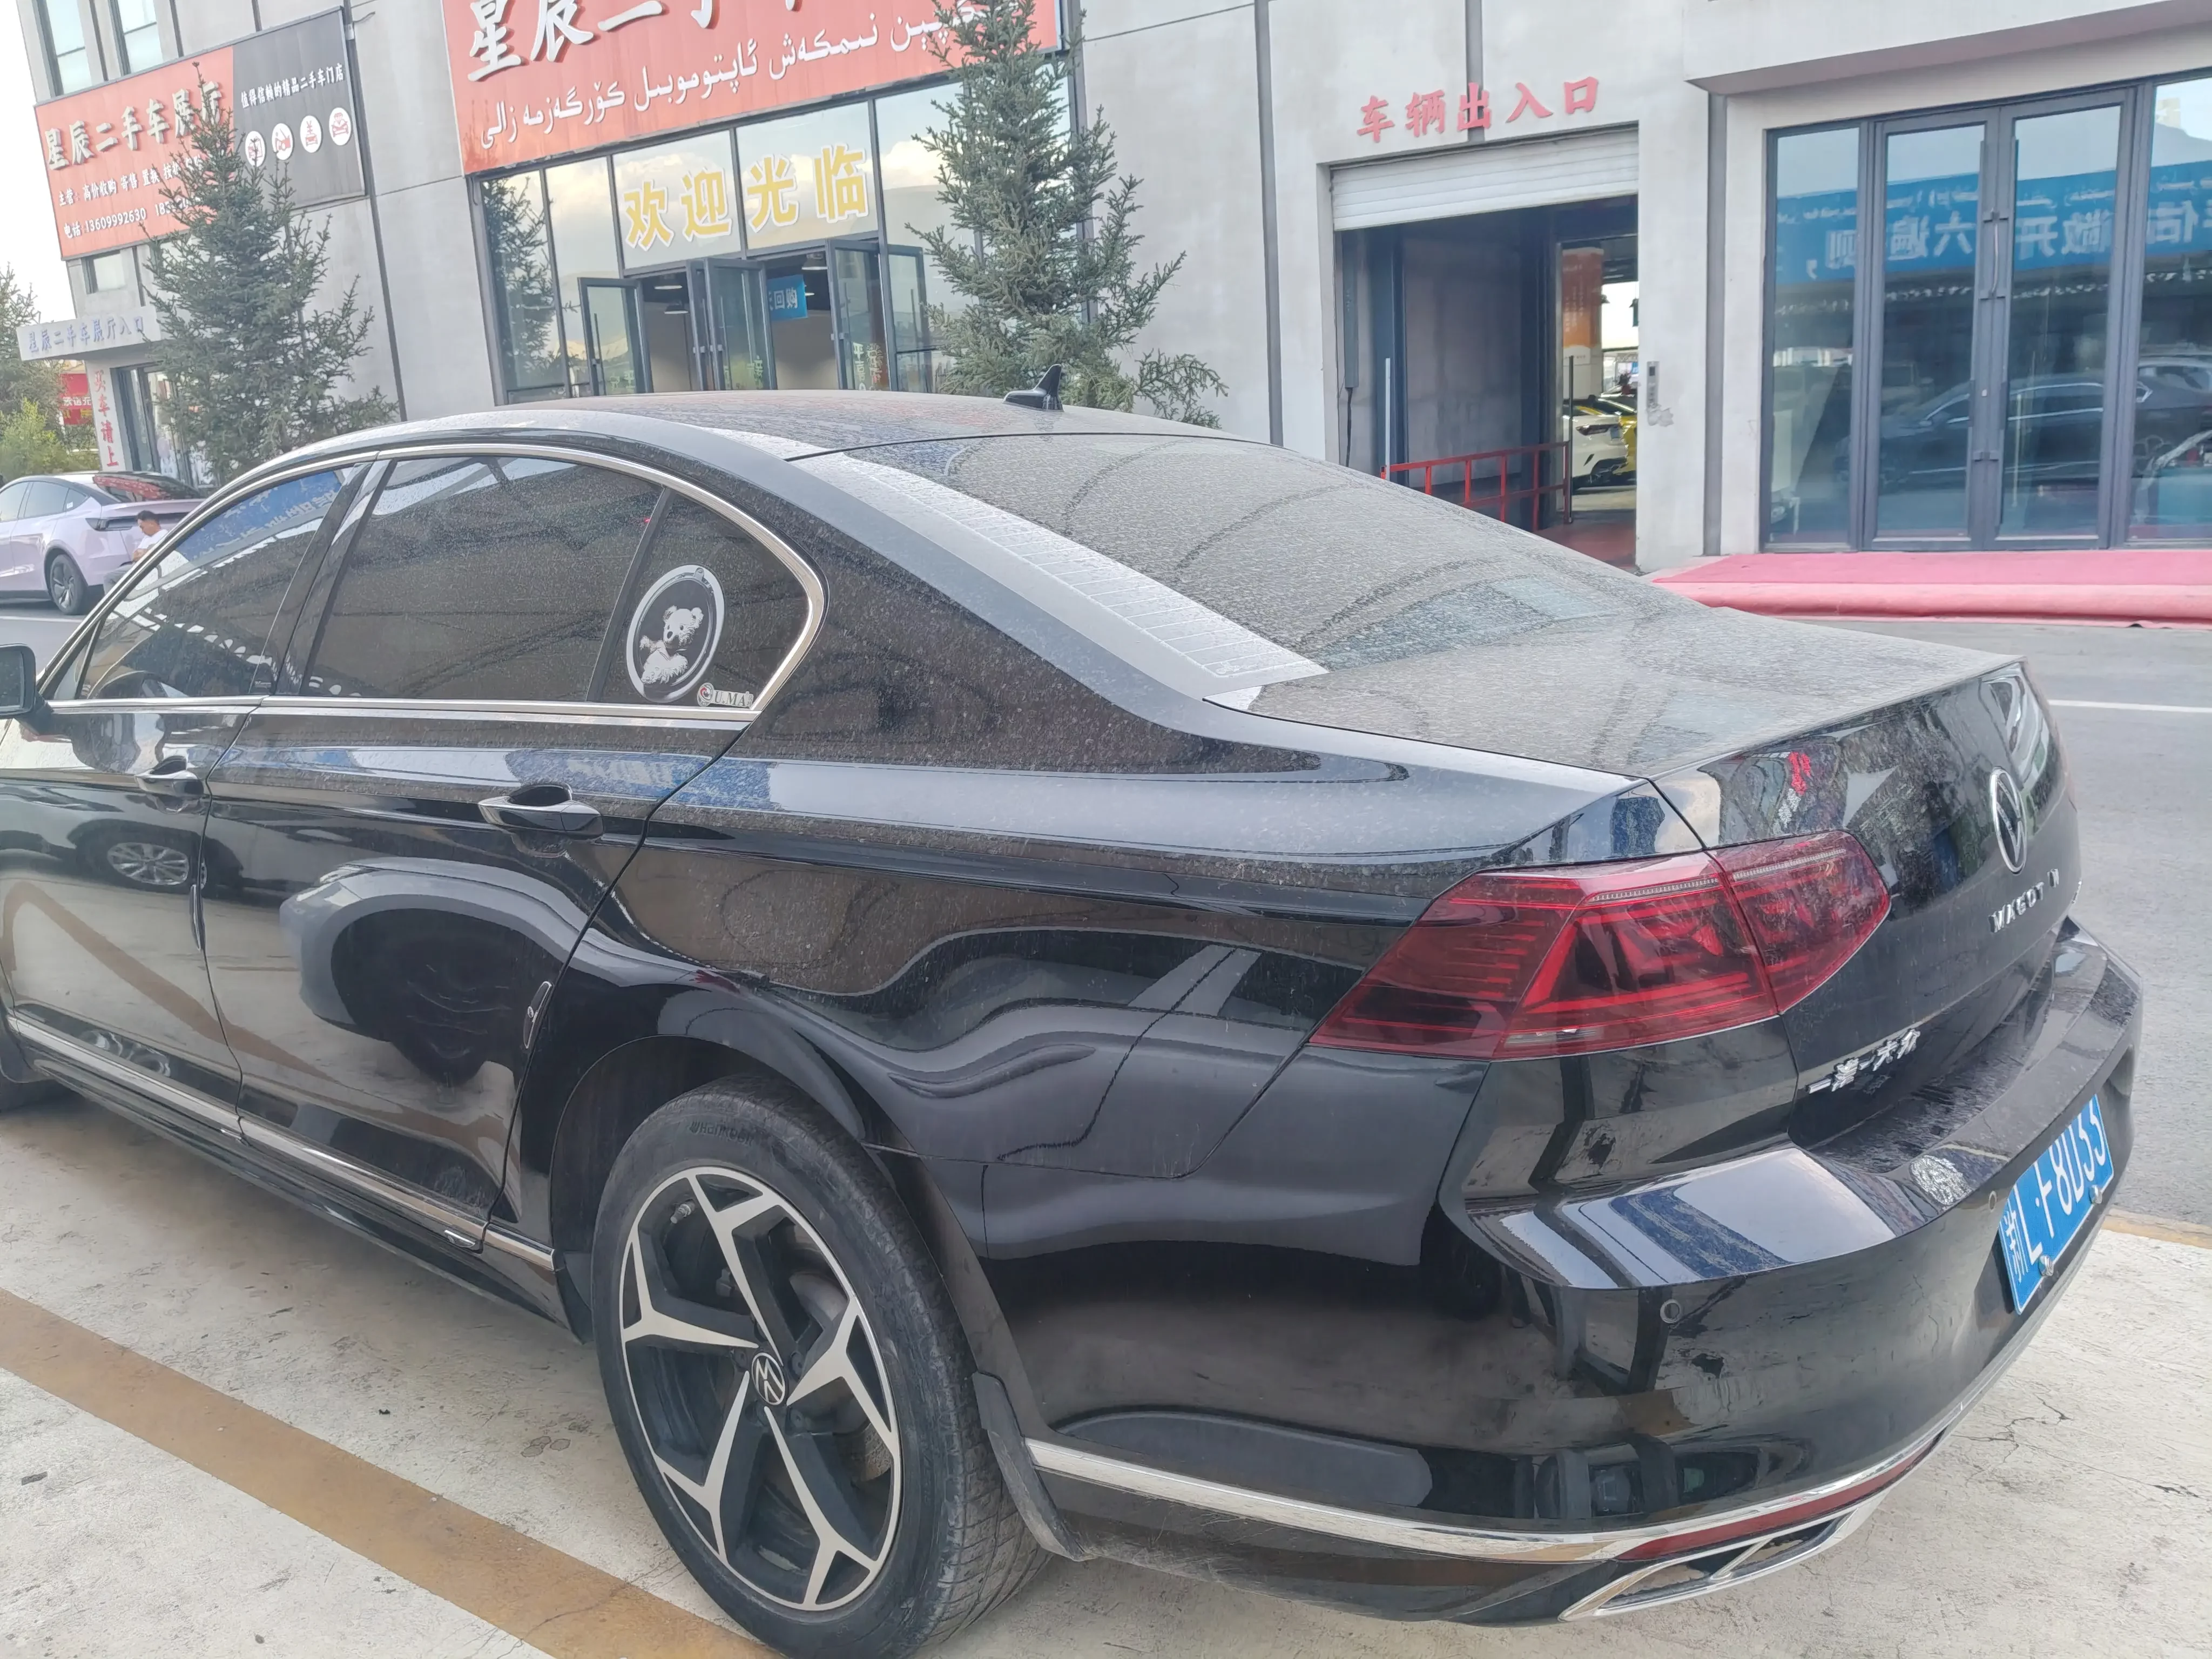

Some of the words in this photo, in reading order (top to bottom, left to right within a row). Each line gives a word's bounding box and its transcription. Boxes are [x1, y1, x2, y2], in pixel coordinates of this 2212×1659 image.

[241, 63, 344, 109] 值得信赖的精品二手车门店
[1357, 76, 1599, 143] 车辆出入口
[44, 80, 223, 171] 星辰二手车展厅
[82, 178, 117, 201] 高价收购
[623, 144, 868, 250] 欢迎光临
[28, 316, 144, 353] 星辰二手车展厅入口
[1987, 868, 2059, 933] MAGOTN
